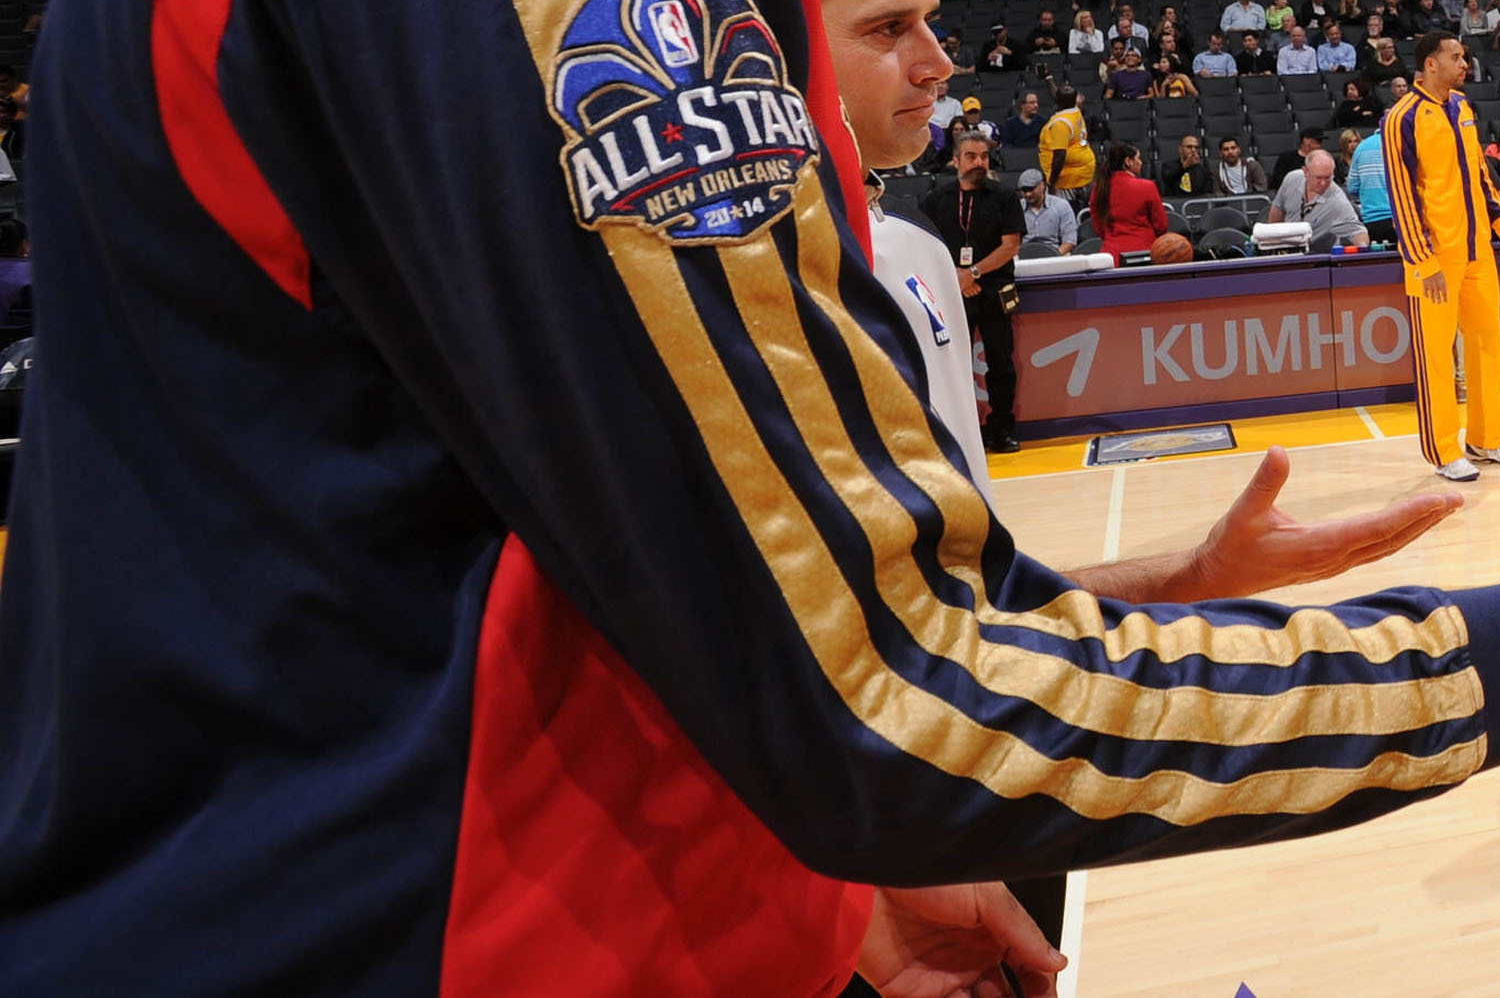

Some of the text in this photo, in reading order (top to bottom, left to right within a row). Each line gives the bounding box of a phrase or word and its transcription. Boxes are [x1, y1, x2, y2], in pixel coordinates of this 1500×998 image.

[570, 85, 818, 220] ALL STAR
[645, 159, 794, 221] NEW ORLEANS
[1140, 305, 1411, 386] KUMHO
